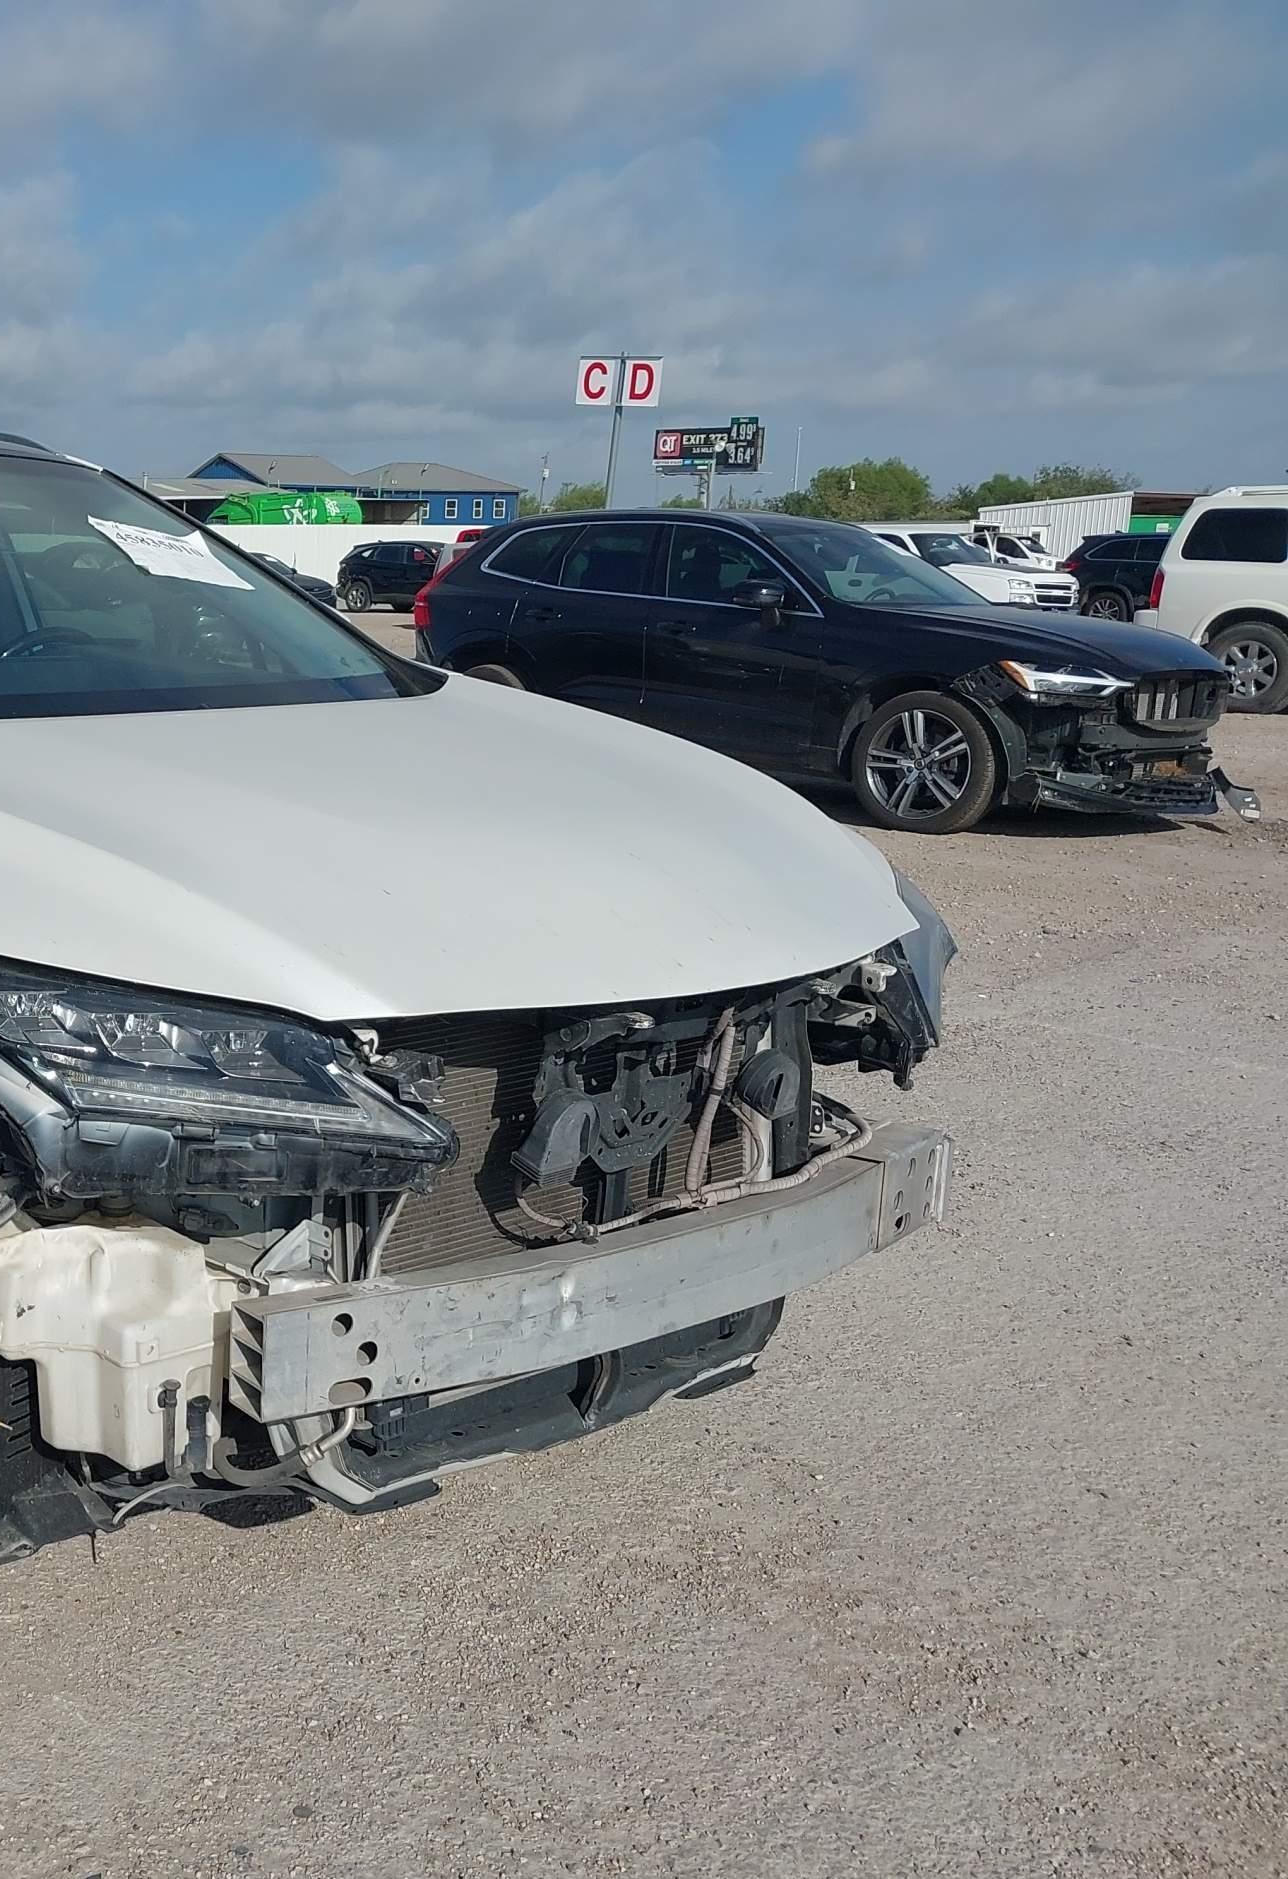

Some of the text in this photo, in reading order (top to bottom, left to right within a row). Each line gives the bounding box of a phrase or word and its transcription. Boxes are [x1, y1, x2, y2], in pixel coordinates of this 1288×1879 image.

[583, 361, 654, 401] C D
[659, 435, 677, 452] QT
[682, 434, 706, 445] EXIT
